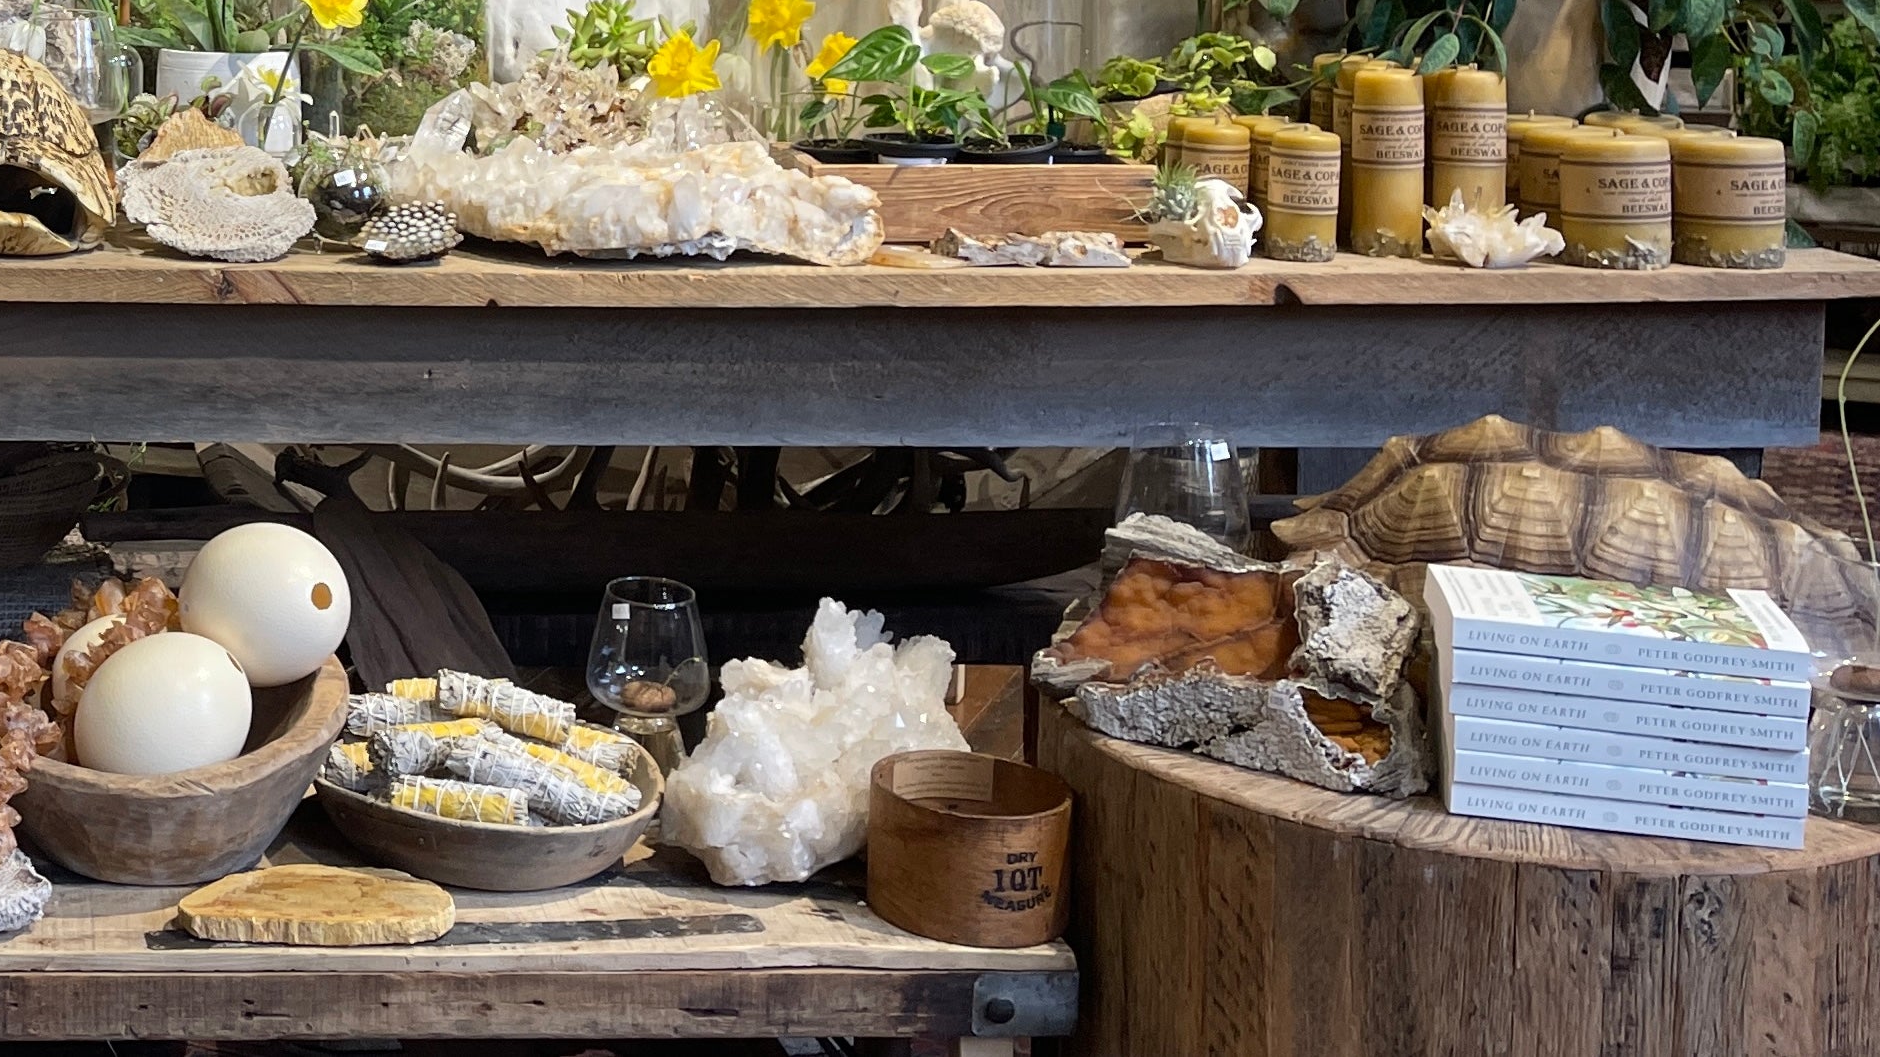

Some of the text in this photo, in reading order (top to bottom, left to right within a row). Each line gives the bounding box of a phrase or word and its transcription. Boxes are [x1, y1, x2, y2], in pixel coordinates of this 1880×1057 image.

[1359, 124, 1394, 135] SAGE
[1396, 125, 1405, 135] &
[1436, 122, 1468, 132] SAGE
[1469, 124, 1479, 133] &
[1450, 147, 1502, 157] BEESWAX
[1195, 162, 1231, 175] SAGE
[1231, 165, 1239, 174] &
[1271, 166, 1301, 180] SAGE
[1303, 172, 1312, 180] &
[1598, 178, 1639, 189] SAGE
[1641, 178, 1649, 189] &
[1730, 180, 1768, 191] SAGE
[1769, 180, 1776, 190] &
[1283, 194, 1333, 205] BEESWAX
[1468, 630, 1589, 651] LIVING ON EARTH
[1638, 647, 1678, 660] PETER
[1470, 666, 1591, 687] LIVING ON EARTH
[1640, 683, 1681, 696] PETER
[1466, 697, 1587, 719] LIVING ON EARTH
[1636, 716, 1677, 728] PETER
[1470, 732, 1590, 753] LIVING ON EARTH
[1639, 749, 1679, 762] PETER
[1470, 766, 1589, 787] LIVING ON EARTH
[1638, 784, 1679, 796] PETER
[1467, 797, 1586, 819] LIVING ON EARTH
[1634, 816, 1675, 828] PETER
[1007, 851, 1038, 864] DRY
